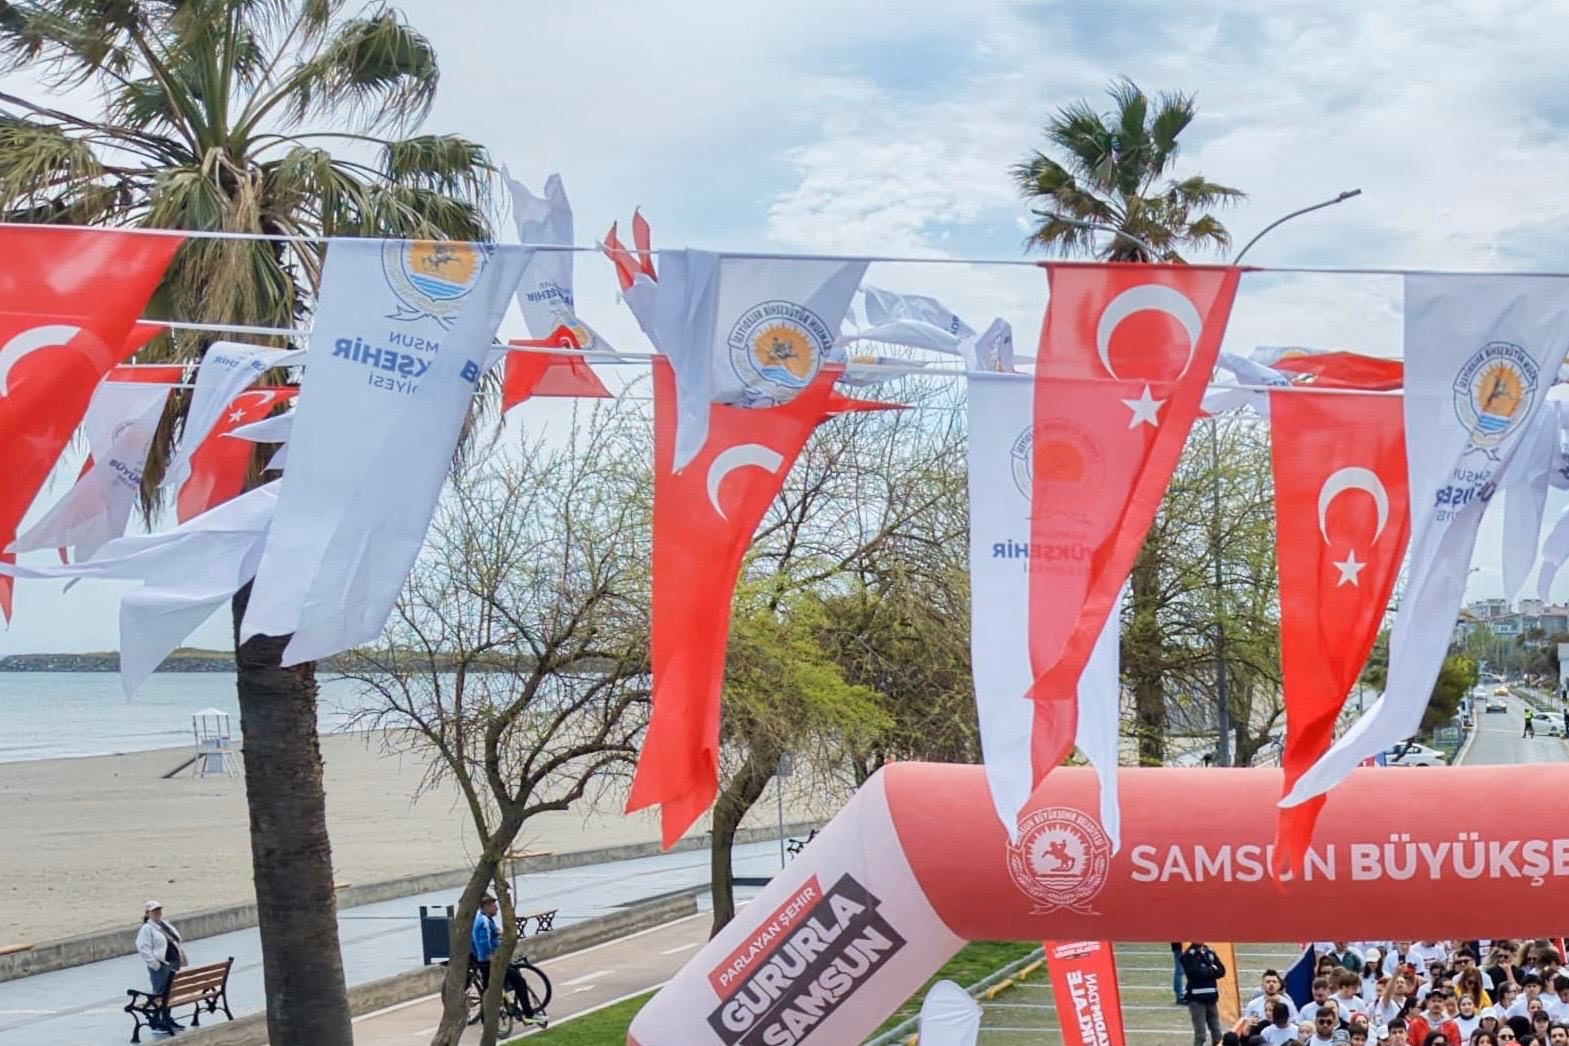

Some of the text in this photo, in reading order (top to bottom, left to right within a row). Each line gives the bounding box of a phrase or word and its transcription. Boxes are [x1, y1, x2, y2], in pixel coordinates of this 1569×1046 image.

[1130, 843, 1336, 883] SAMSUN
[719, 922, 781, 987] PARLAYAN
[721, 893, 867, 1033] GURURLA
